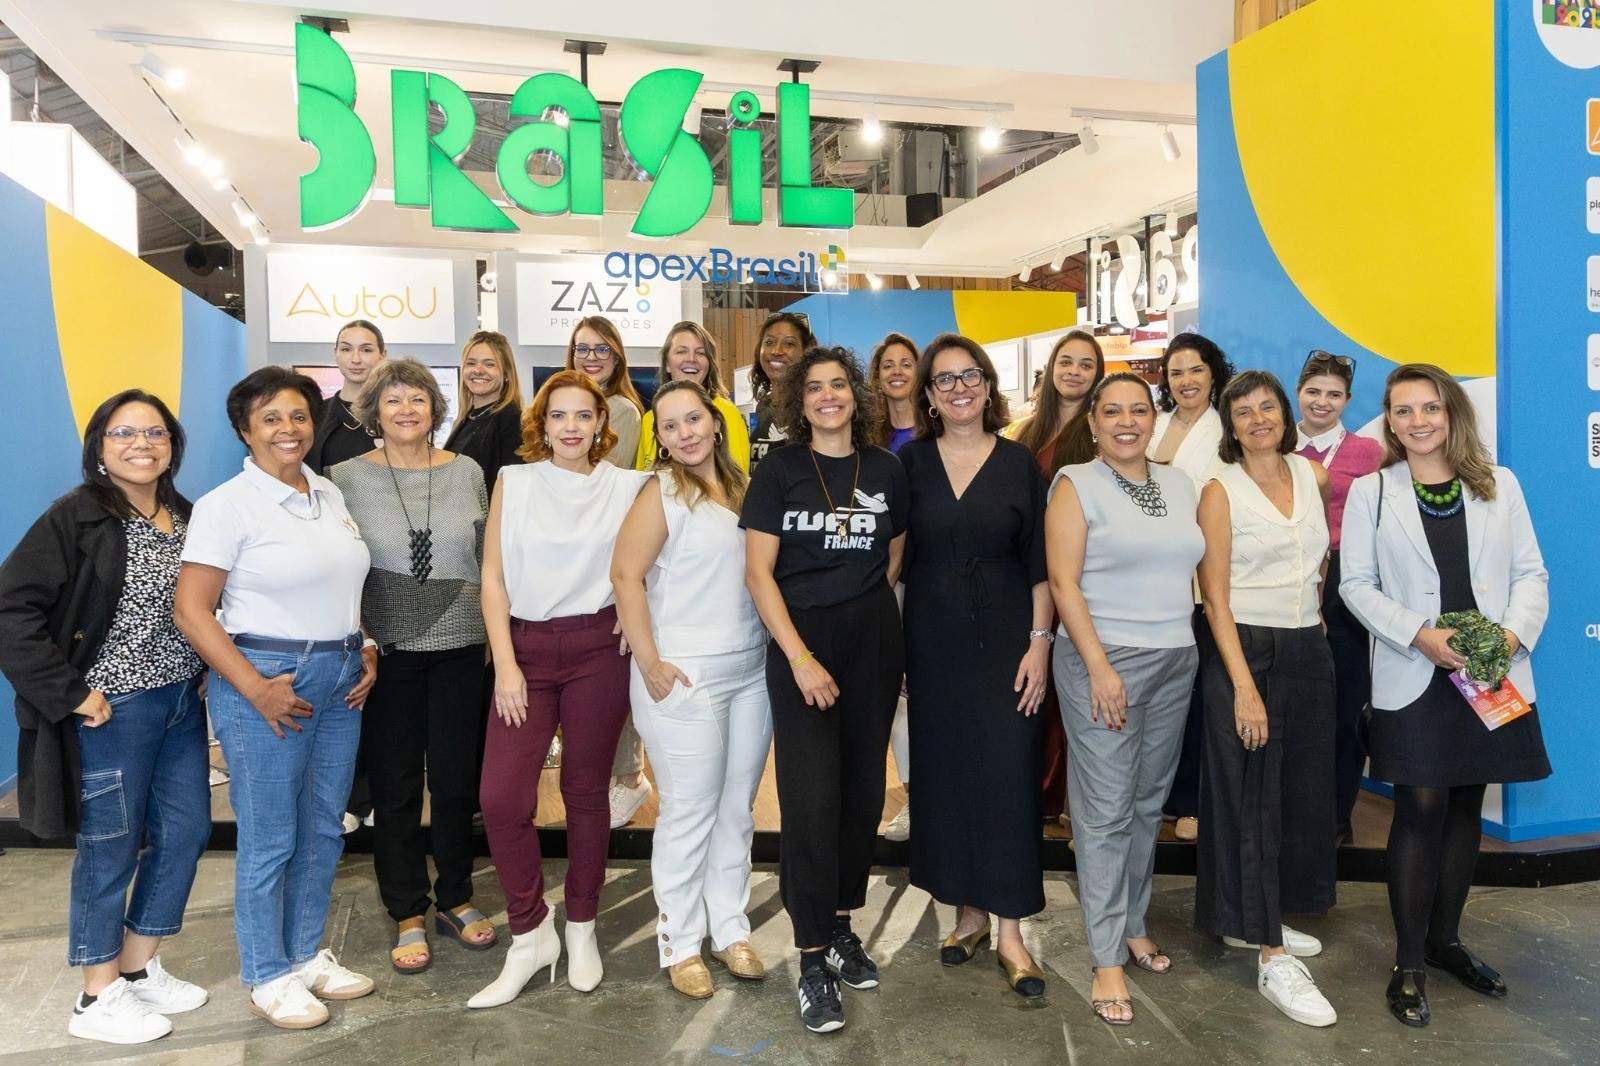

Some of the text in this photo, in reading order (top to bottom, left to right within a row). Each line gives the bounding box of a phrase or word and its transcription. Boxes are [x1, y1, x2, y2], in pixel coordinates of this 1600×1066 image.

[604, 248, 819, 287] apexBrasil
[287, 282, 437, 319] AutoU
[551, 280, 629, 313] ZAZ
[782, 510, 877, 534] CUFA
[824, 534, 874, 550] FRANCE
